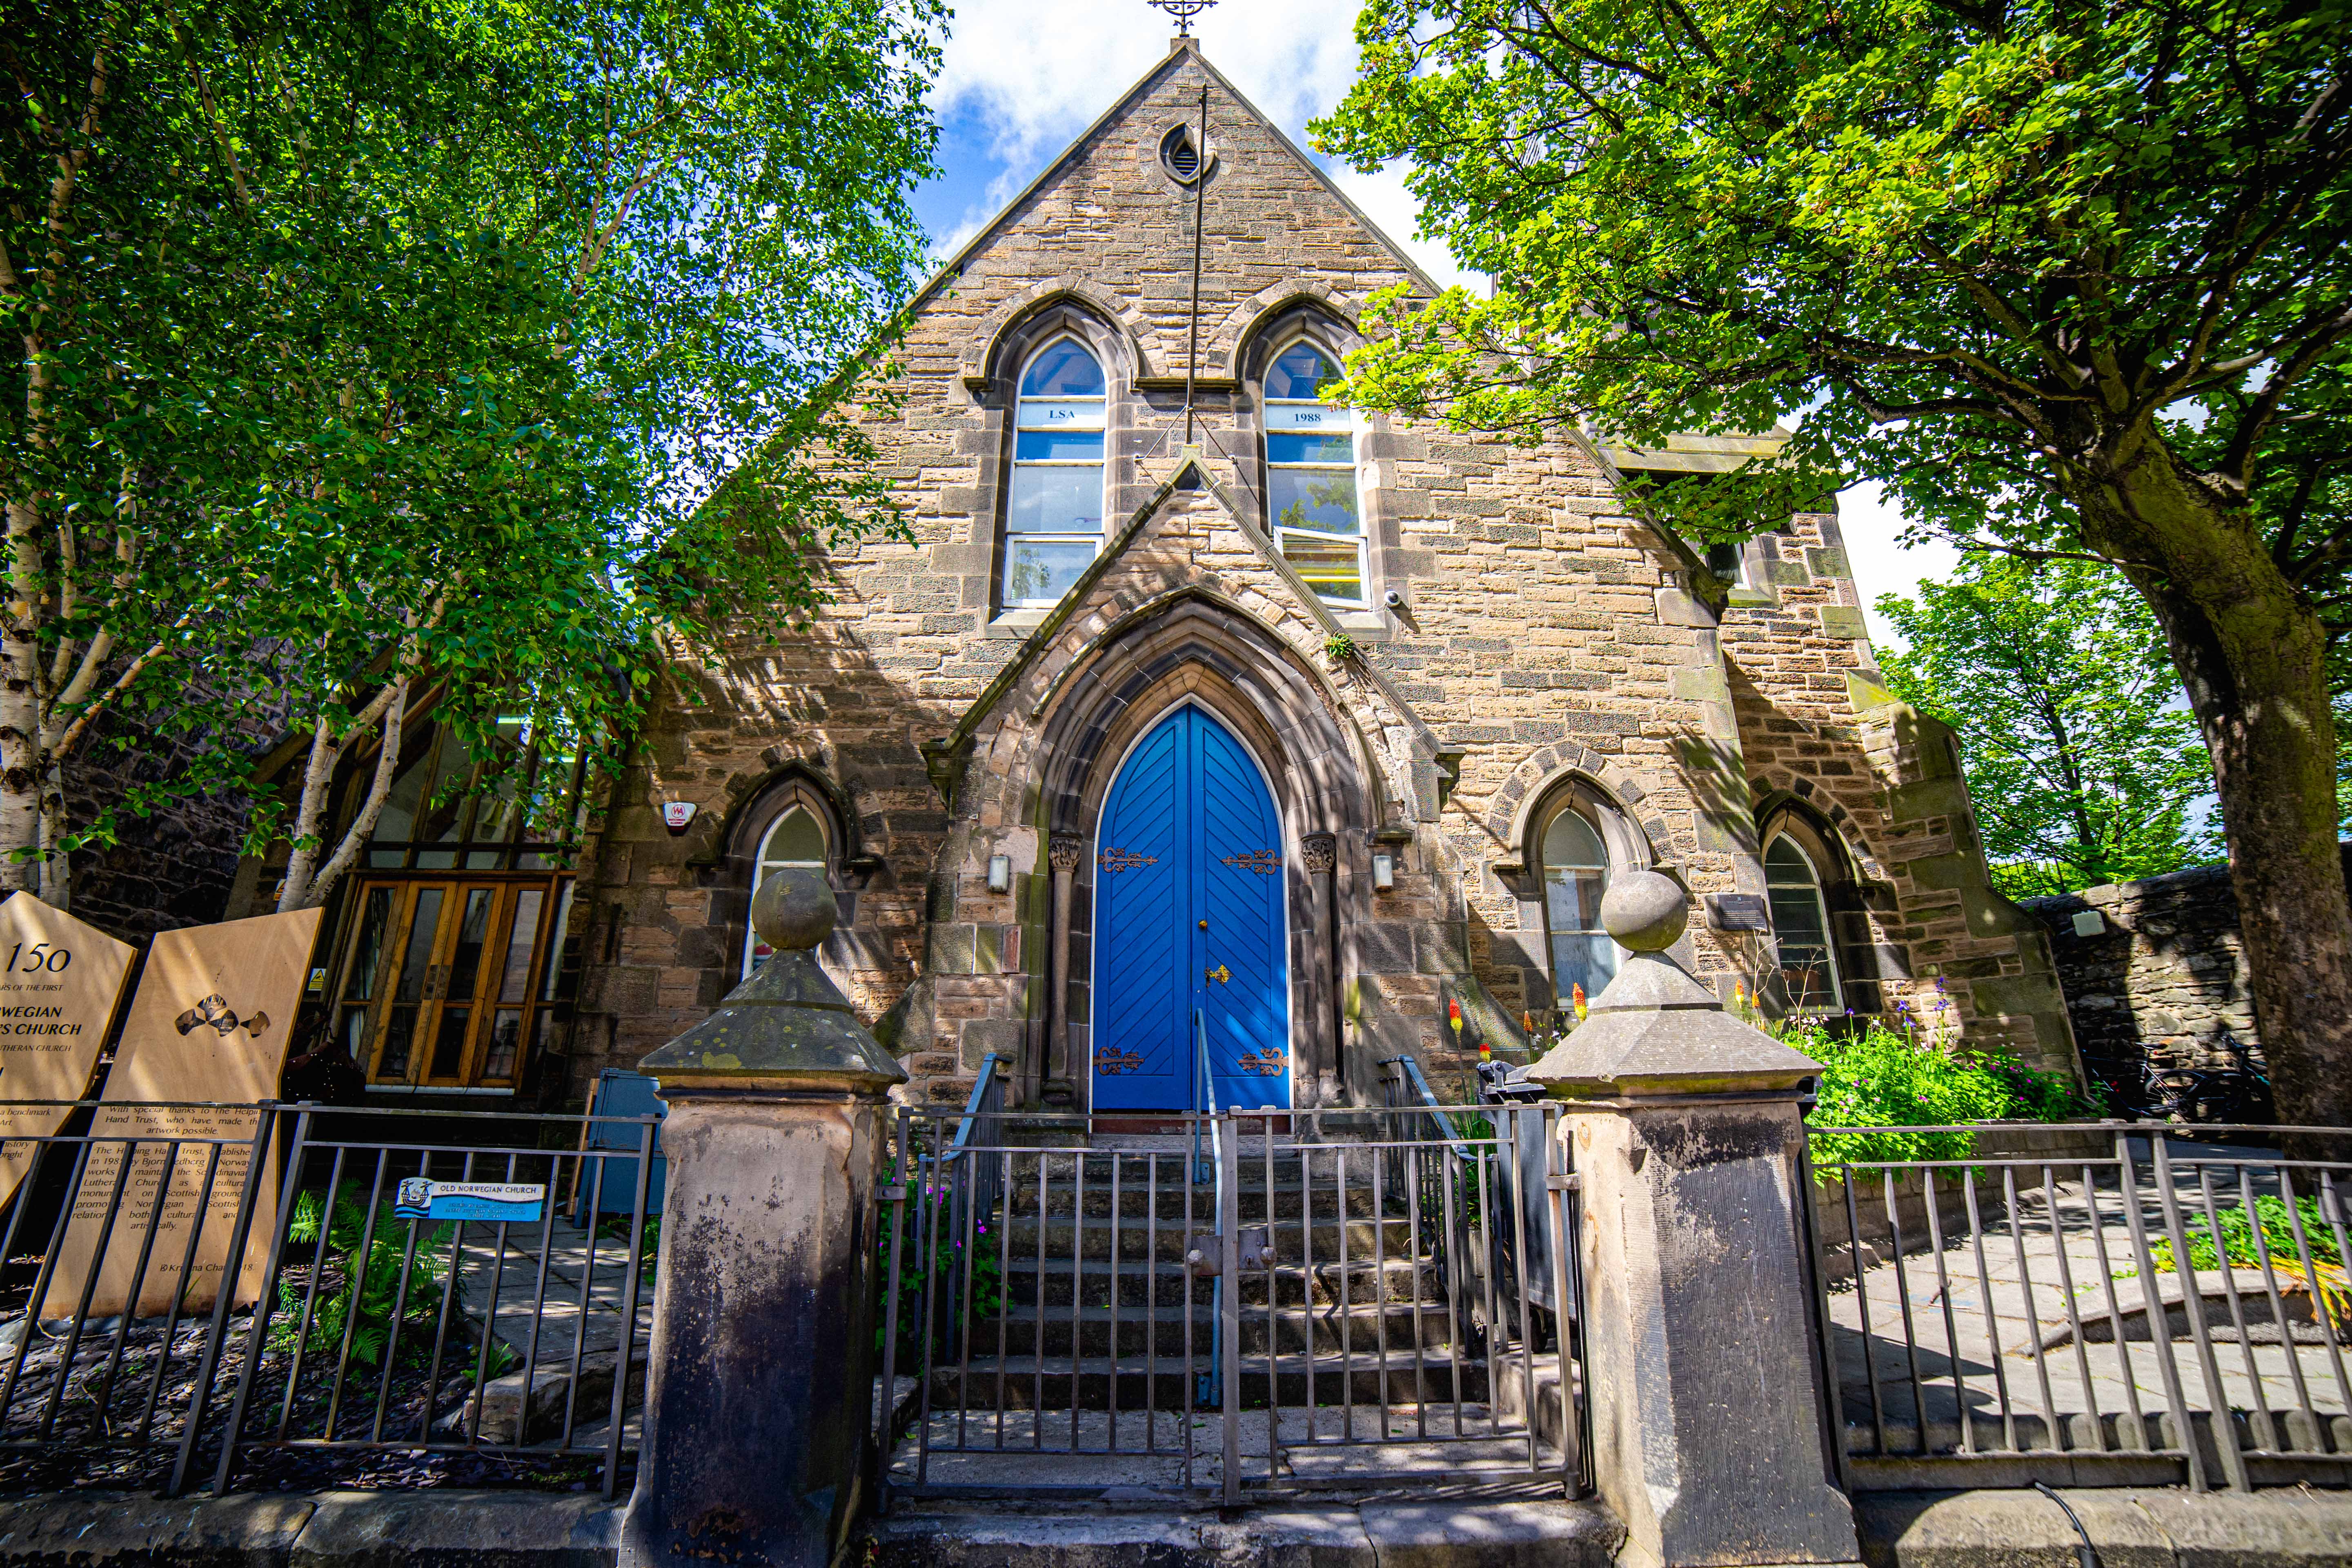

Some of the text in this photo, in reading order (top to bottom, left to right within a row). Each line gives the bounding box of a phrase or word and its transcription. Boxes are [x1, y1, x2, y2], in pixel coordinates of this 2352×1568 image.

[1050, 410, 1075, 418] LSA
[1295, 413, 1321, 422] 1988
[7, 943, 71, 972] 150
[0, 1006, 62, 1017] WEGIAN
[15, 1023, 82, 1035] CHURCH
[136, 1116, 158, 1124] Trust,
[182, 1127, 219, 1135] possible.
